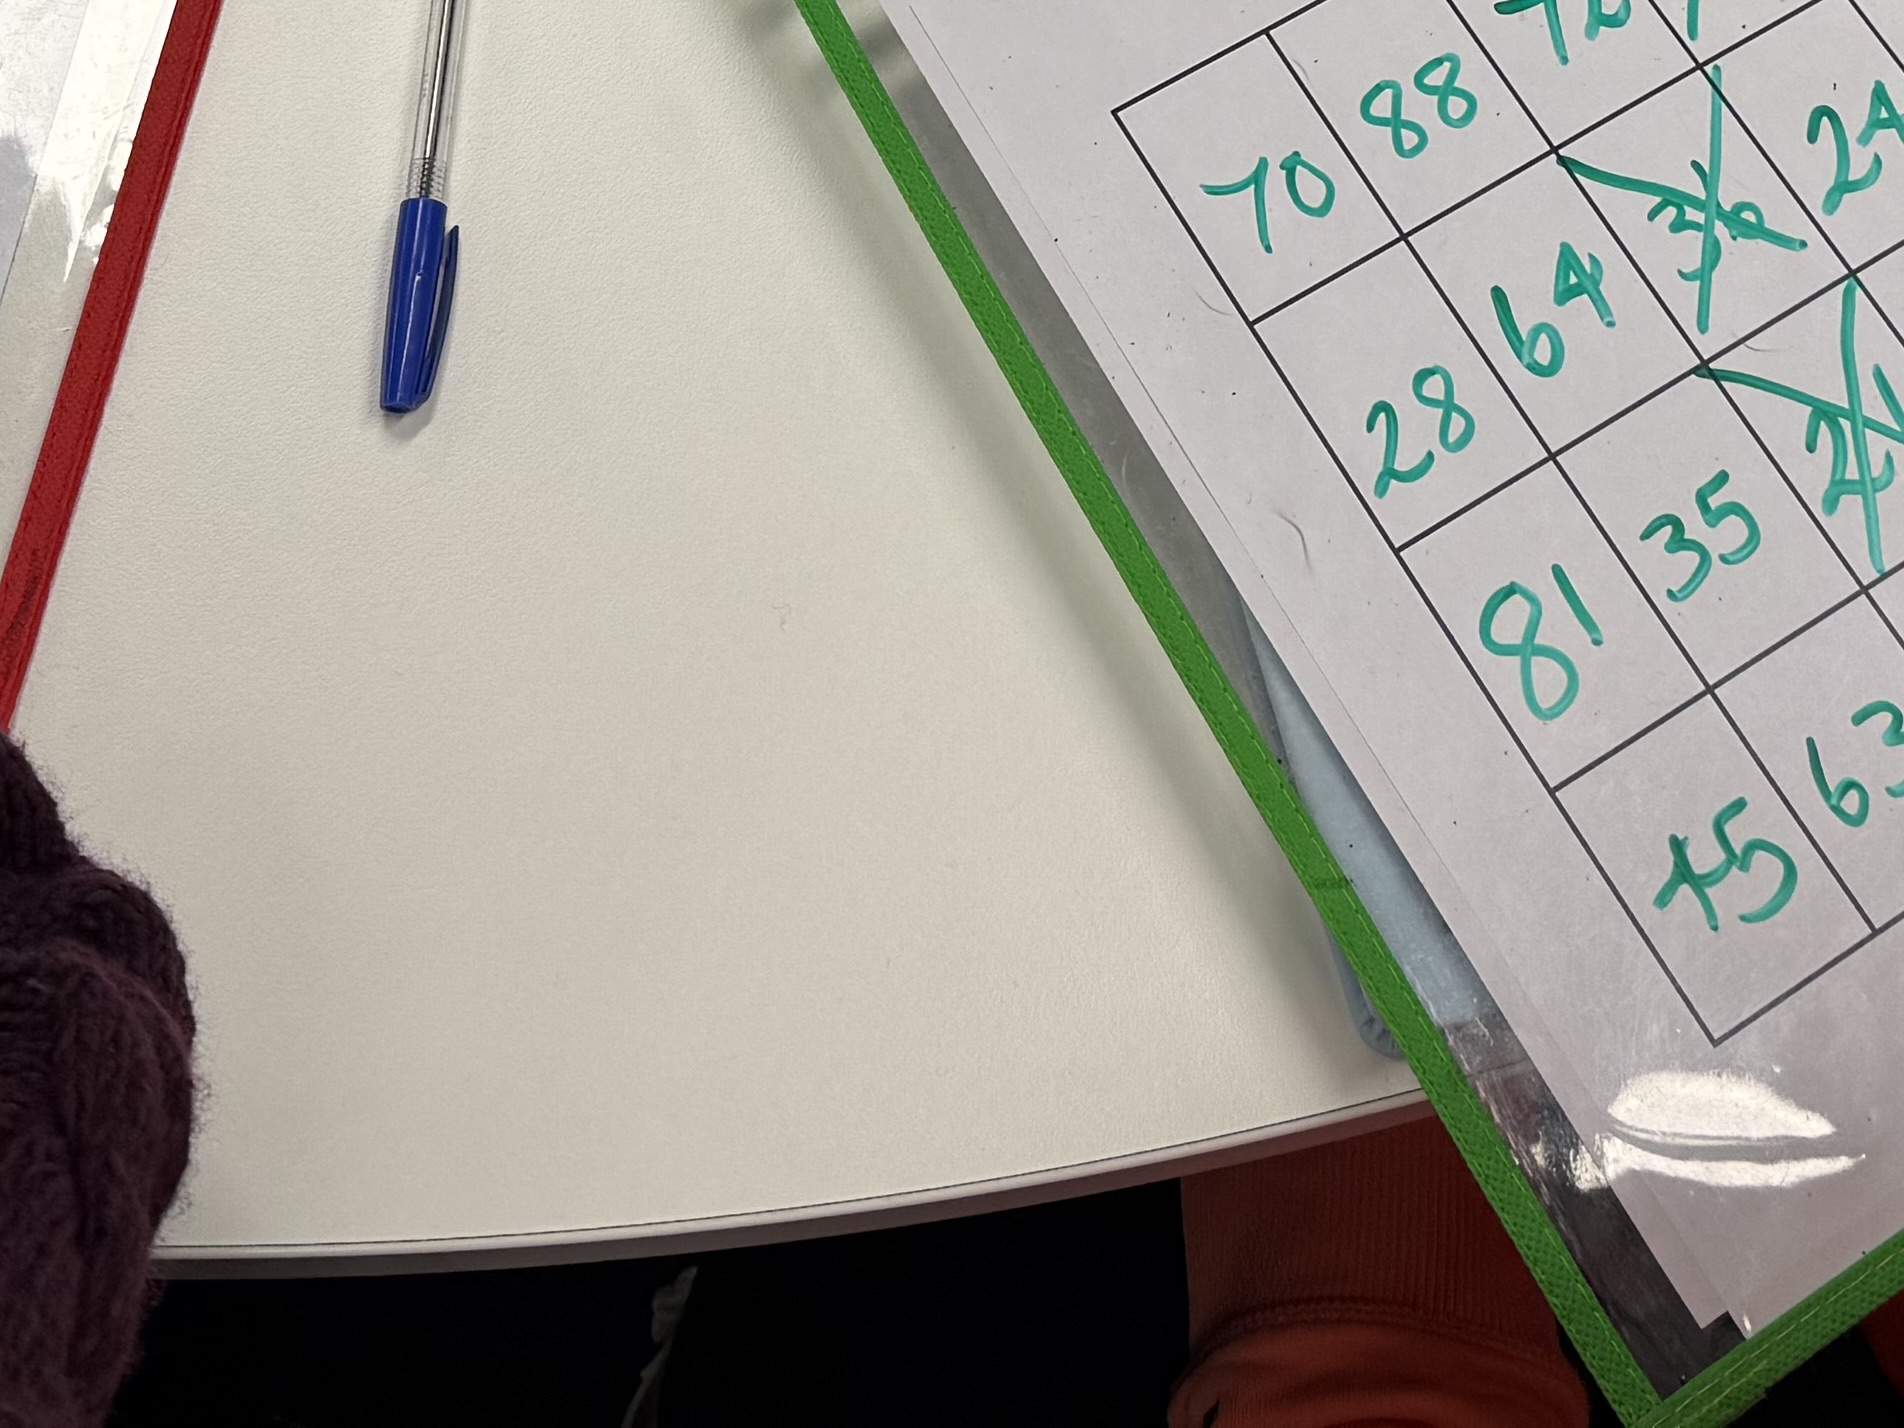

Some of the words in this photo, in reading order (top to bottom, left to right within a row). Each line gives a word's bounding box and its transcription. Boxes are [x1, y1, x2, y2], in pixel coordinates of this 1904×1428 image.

[1200, 150, 1336, 254] 70
[1360, 51, 1480, 159] 88
[1363, 364, 1478, 499] 28
[1488, 241, 1617, 378] 64
[1479, 563, 1605, 721] 81
[1638, 468, 1764, 603] 35
